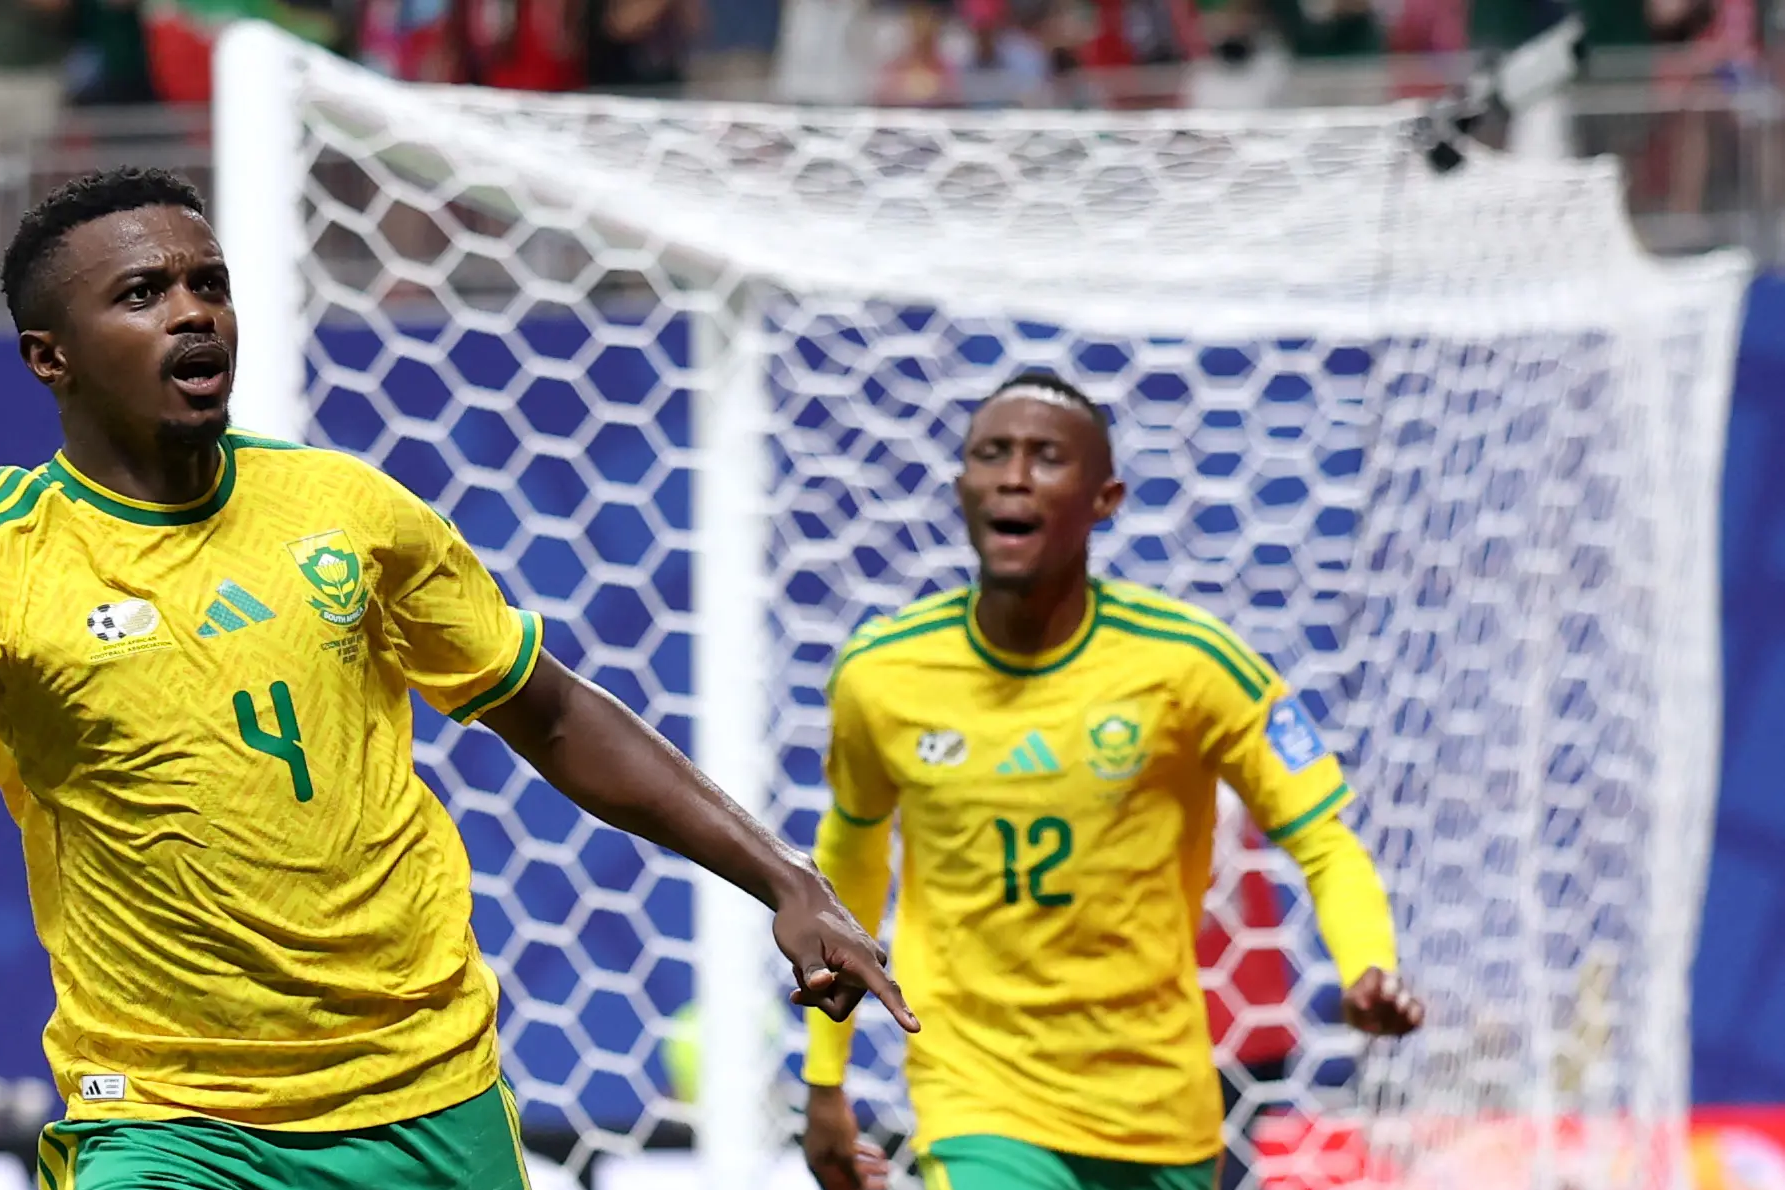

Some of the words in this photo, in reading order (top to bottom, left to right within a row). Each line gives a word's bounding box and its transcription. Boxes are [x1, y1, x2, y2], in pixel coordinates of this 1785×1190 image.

[323, 611, 346, 623] SOUTH
[90, 649, 125, 660] FOOTBALL
[127, 640, 173, 652] ASSOCIATION
[232, 680, 314, 803] 4
[994, 815, 1073, 906] 12
